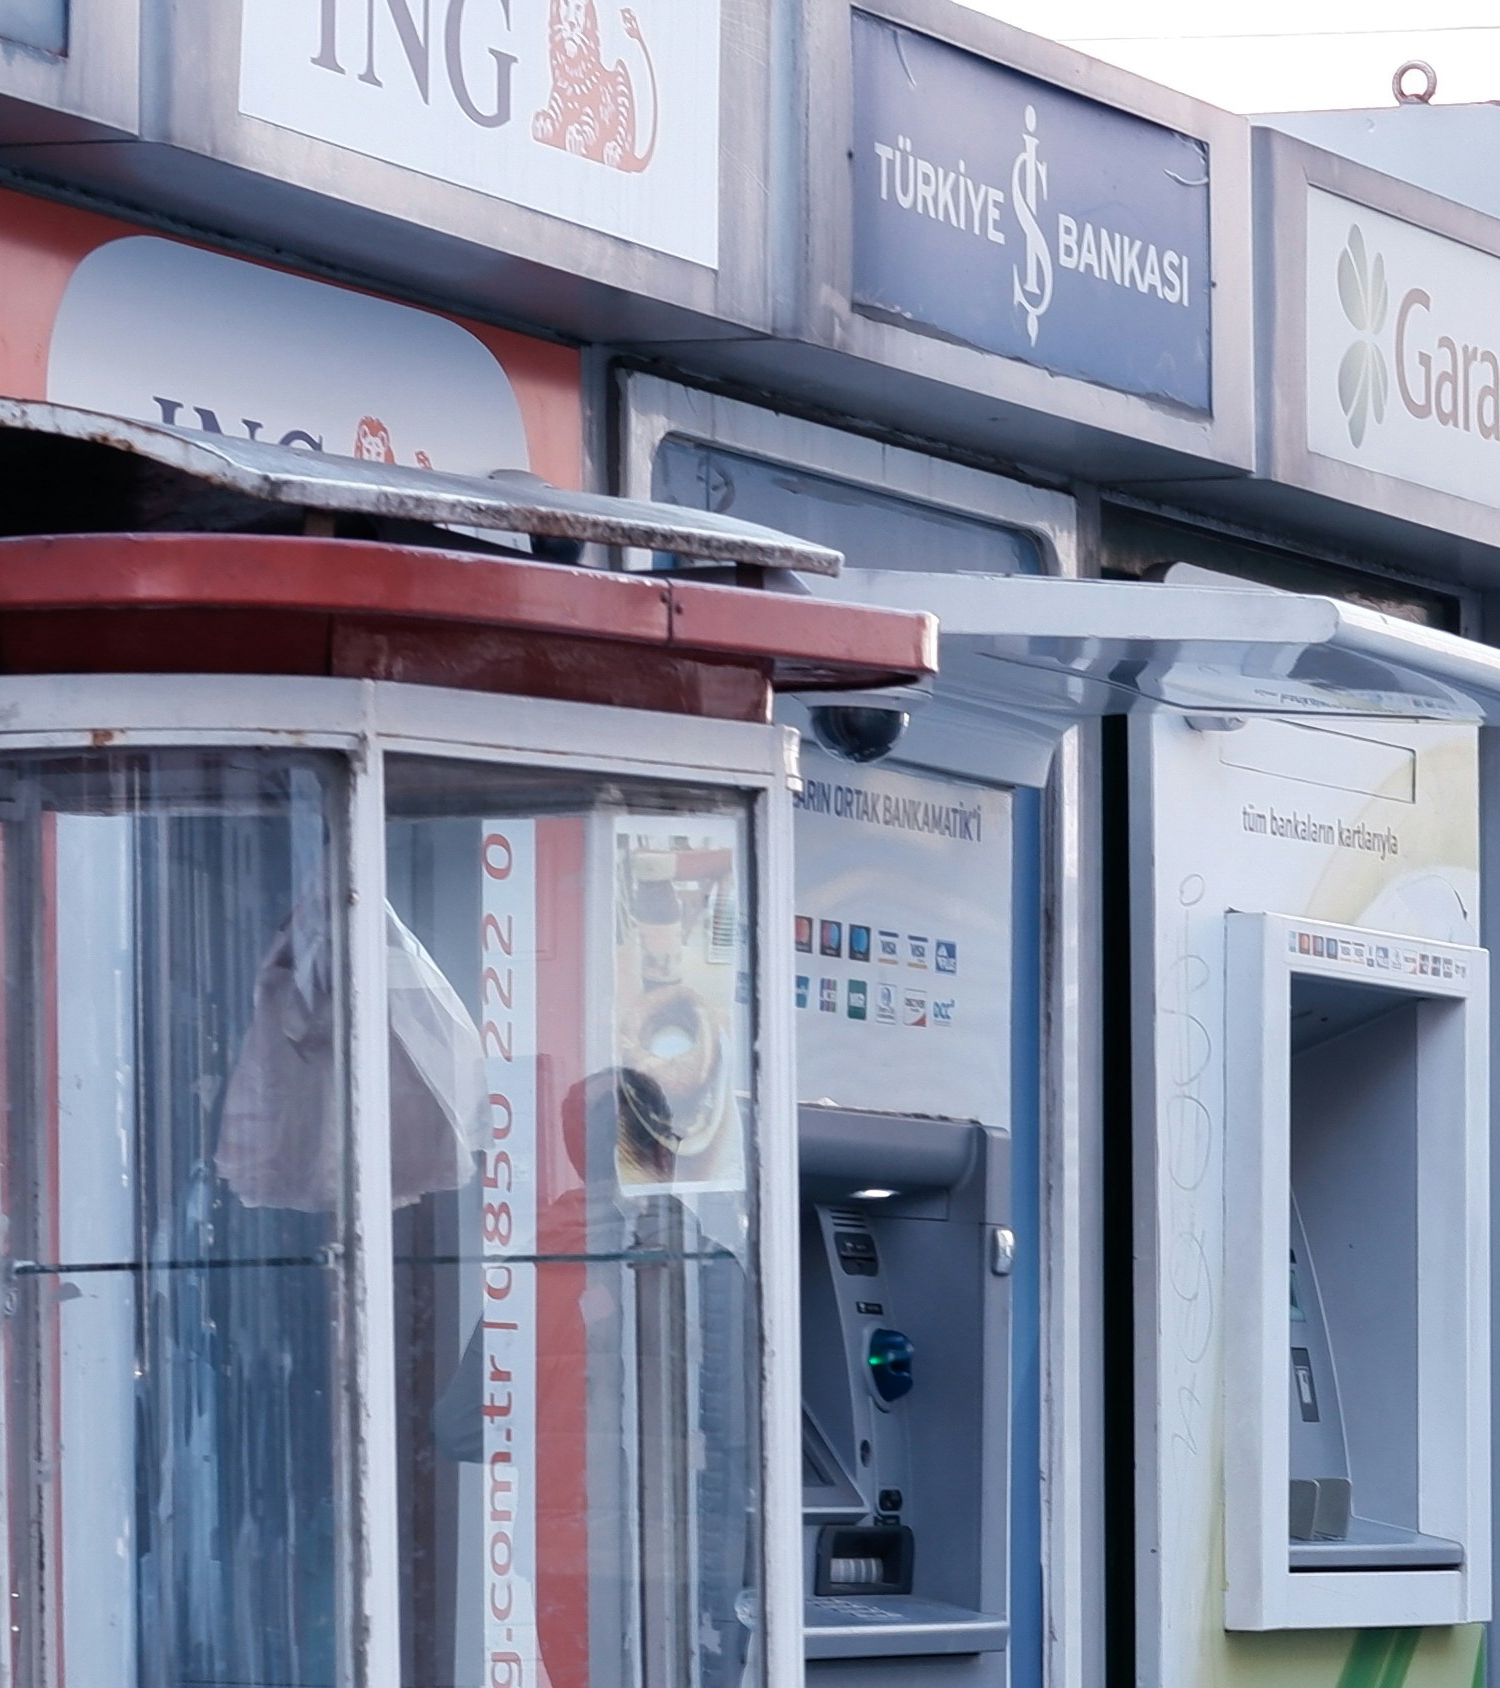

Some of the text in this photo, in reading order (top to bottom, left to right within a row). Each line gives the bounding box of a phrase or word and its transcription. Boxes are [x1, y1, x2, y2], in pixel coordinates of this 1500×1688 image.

[310, 0, 518, 128] ING
[874, 134, 1006, 246] TÜRKİYE
[1057, 213, 1190, 308] BANKASI
[834, 785, 881, 825] ORTAK
[1242, 803, 1267, 834] tüm
[483, 913, 514, 1063] 222
